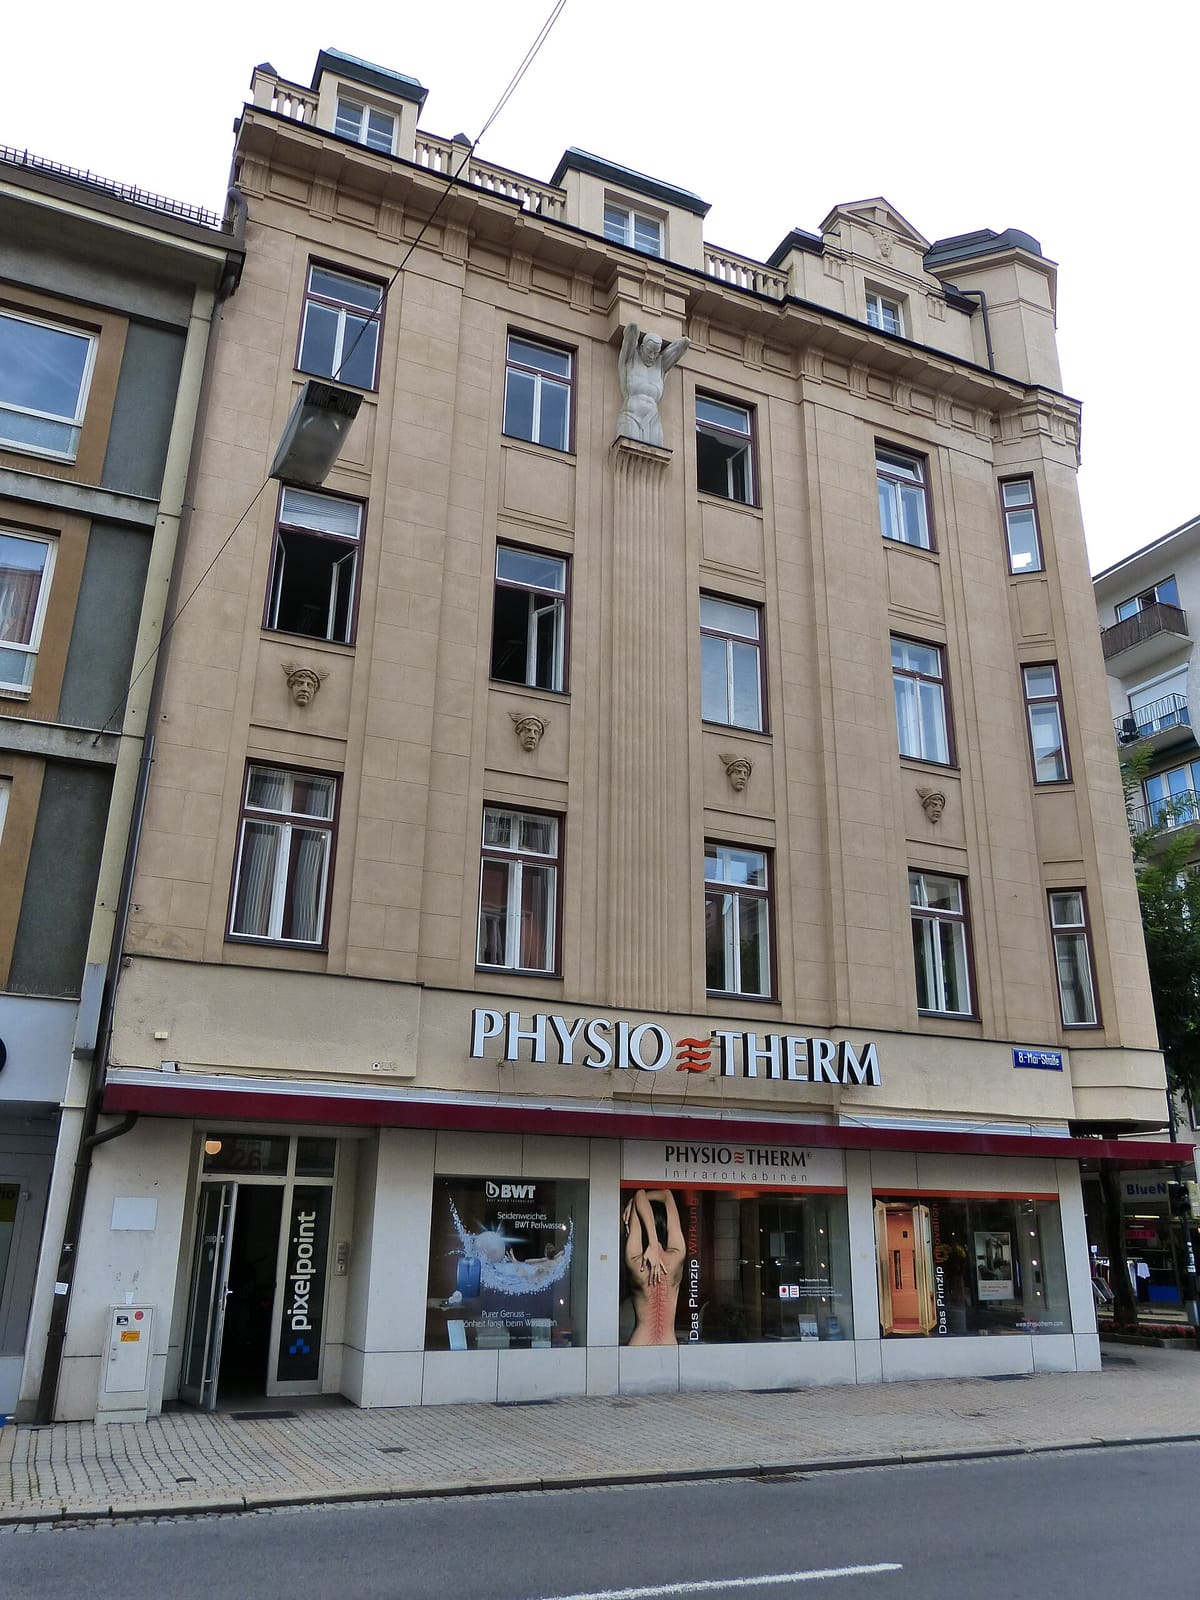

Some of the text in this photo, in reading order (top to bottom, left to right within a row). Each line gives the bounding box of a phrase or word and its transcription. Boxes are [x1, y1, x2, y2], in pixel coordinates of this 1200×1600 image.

[469, 1007, 881, 1086] PHYSIO THERM
[665, 1145, 806, 1167] PHYSIO THERM
[664, 1167, 808, 1182] Infrarotkabinen
[501, 1184, 536, 1199] BWT
[497, 1211, 547, 1220] Seidenweiches
[514, 1220, 565, 1230] BWT Perlwasse
[287, 1211, 317, 1331] pixelpoint
[688, 1259, 700, 1308] Prinzip
[936, 1266, 944, 1307] Prinzip
[481, 1310, 499, 1319] Purer
[499, 1309, 525, 1318] Genuss
[505, 1319, 524, 1327] beim
[938, 1310, 947, 1334] Das
[689, 1312, 699, 1341] Das
